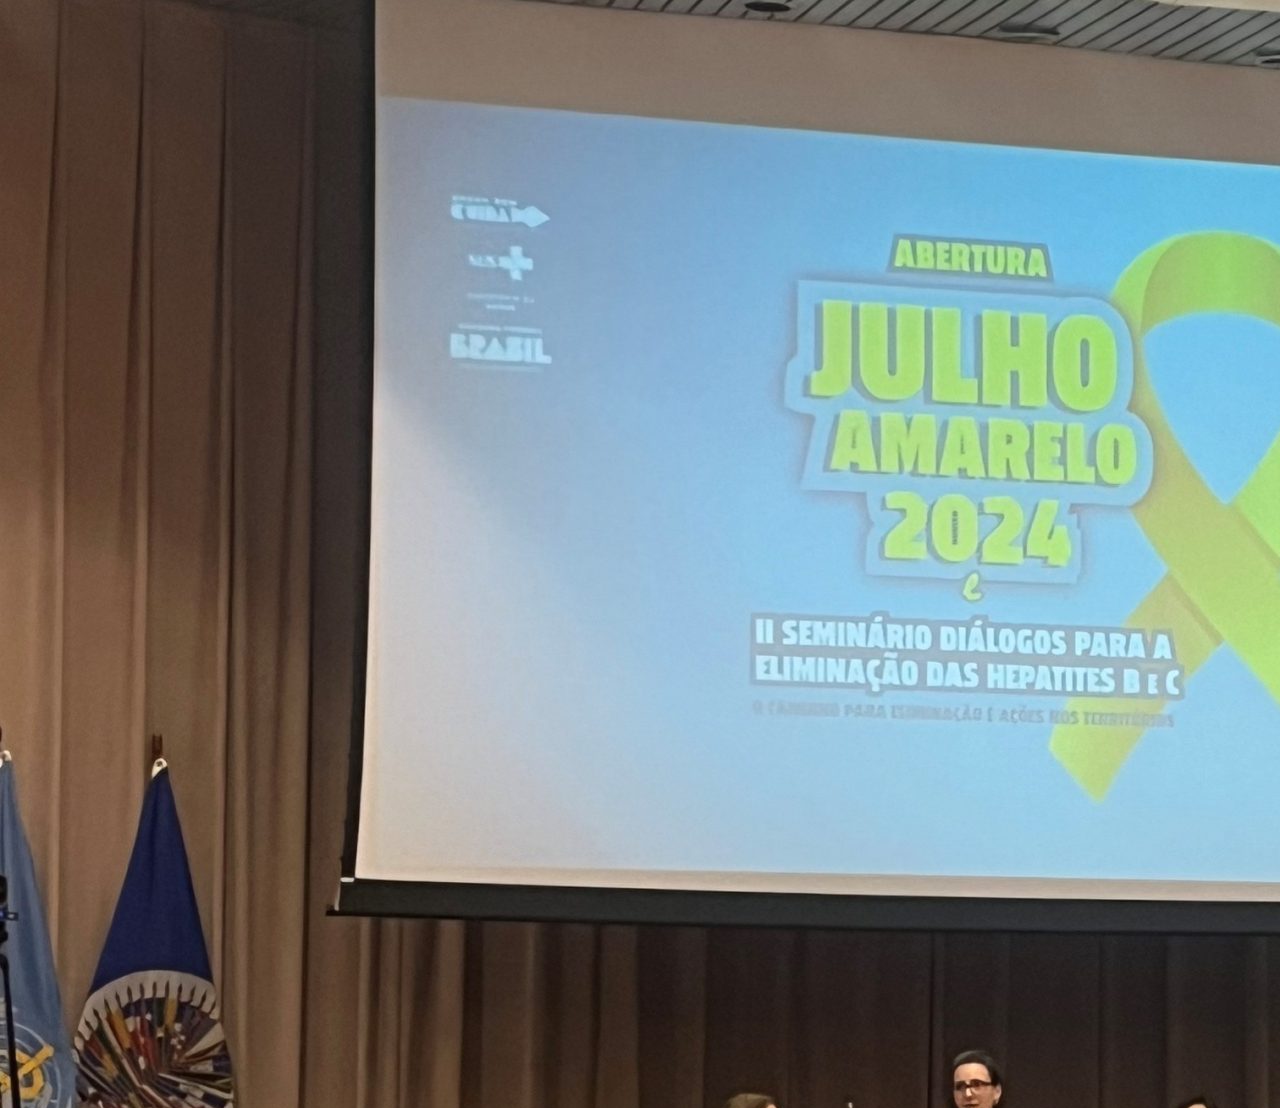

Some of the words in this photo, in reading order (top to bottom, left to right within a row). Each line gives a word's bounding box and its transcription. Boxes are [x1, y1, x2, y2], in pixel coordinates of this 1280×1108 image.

[895, 239, 1047, 277] ABERTURA
[810, 299, 1118, 412] JULHO
[829, 409, 1137, 485] AMARELO
[883, 490, 1072, 567] 2024
[755, 618, 774, 644] II
[781, 616, 932, 650] SEMINÁRIO
[940, 620, 1068, 656] DIÁLOGOS
[1074, 630, 1146, 659] PARA
[1152, 633, 1173, 660] A
[755, 651, 919, 692] ELIMINAÇÃO
[926, 661, 979, 688] DAS
[986, 663, 1116, 694] HEPATITES
[1123, 667, 1141, 694] B
[1165, 669, 1181, 695] C
